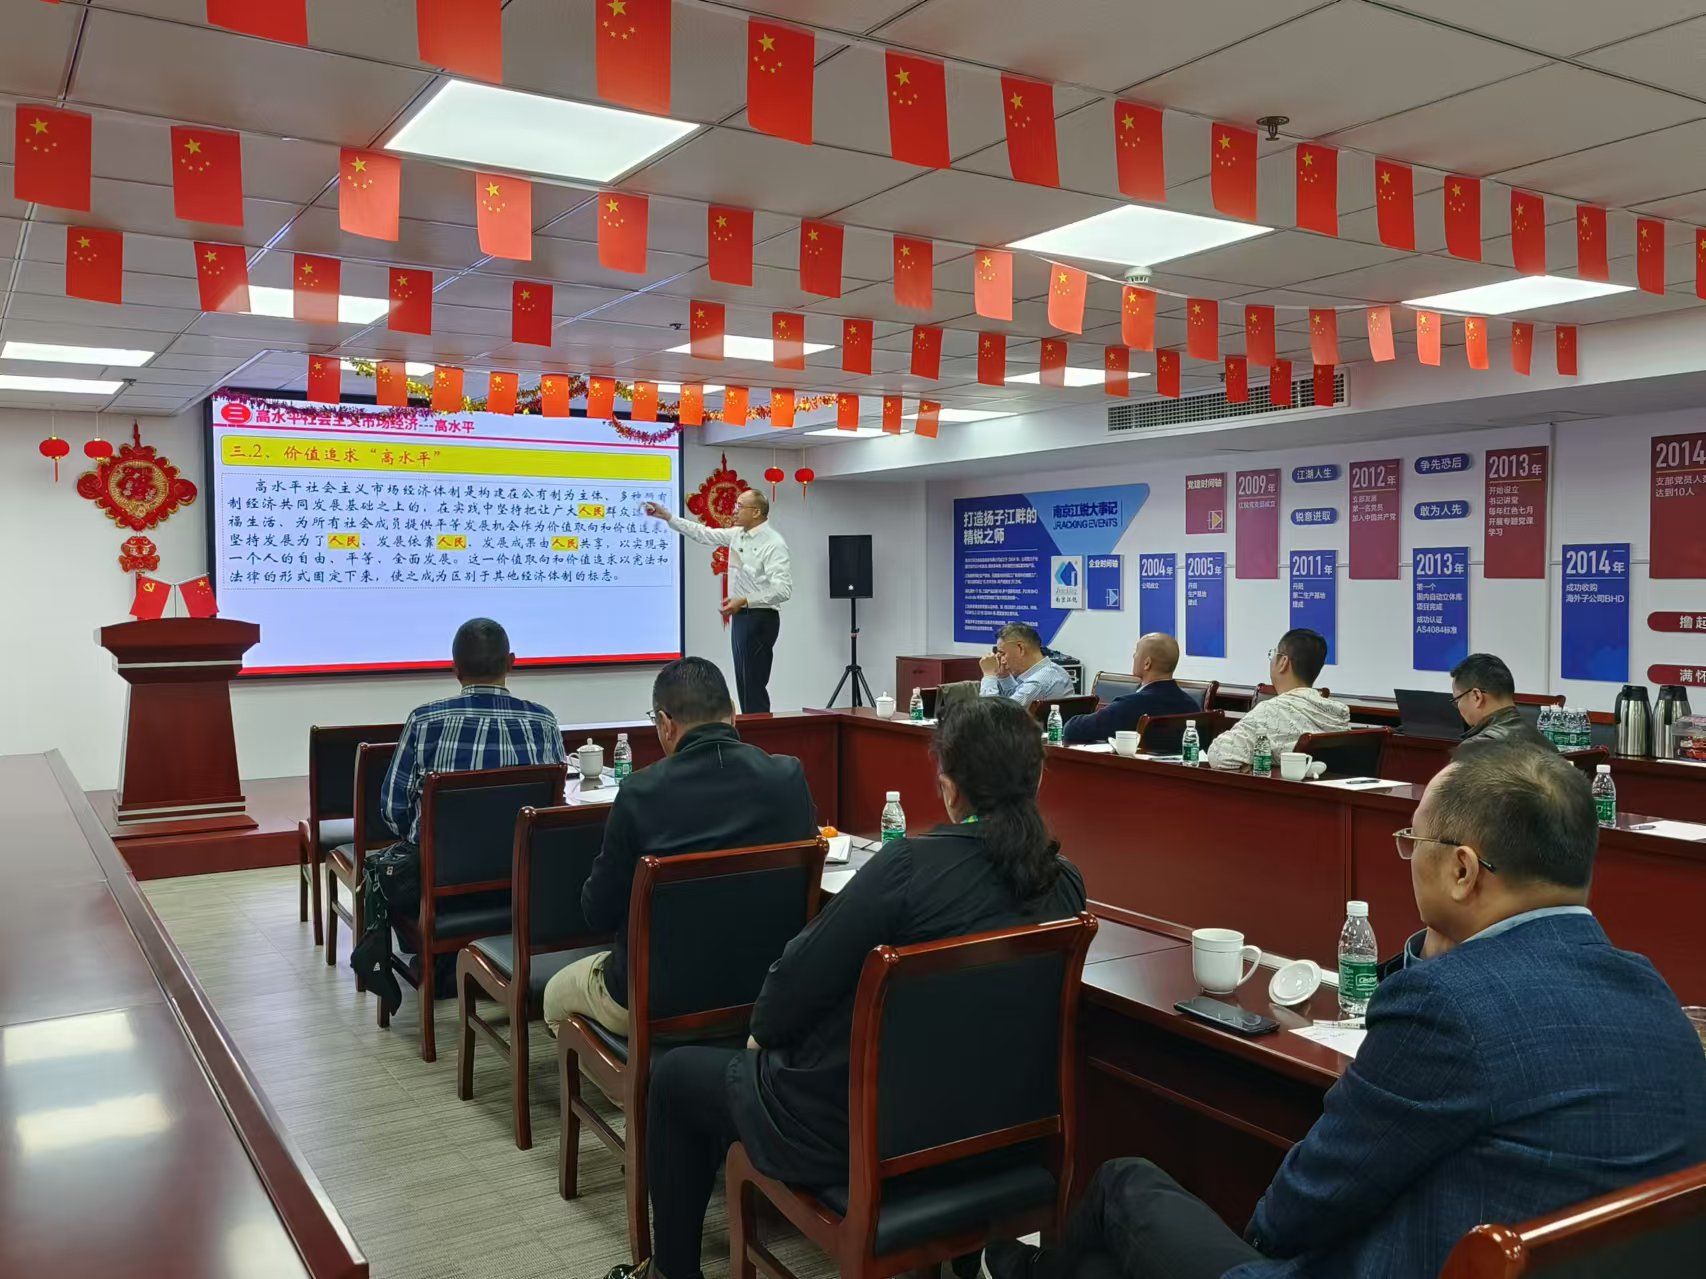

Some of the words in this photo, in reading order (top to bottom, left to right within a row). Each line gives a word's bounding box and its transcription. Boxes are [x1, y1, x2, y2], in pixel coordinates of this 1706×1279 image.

[228, 407, 245, 420] 三
[1420, 459, 1462, 471] 争先恐后
[1489, 453, 1542, 478] 2013年
[1297, 468, 1332, 480] 江湖人生
[1352, 466, 1396, 488] 2012年
[1239, 475, 1276, 494] 2009年
[1488, 486, 1519, 495] 开始设立
[1655, 487, 1695, 497] 达到10人
[1488, 496, 1519, 505] 书记讲堂
[1053, 501, 1118, 519] 南京江锐大事记
[1420, 503, 1462, 516] 敢为人先
[1488, 506, 1534, 516] 每年红色七月
[964, 507, 1038, 527] 打造扬子江畔的
[1295, 510, 1331, 522] 锐意进取
[1352, 513, 1396, 522] 加入中国共产党
[1088, 517, 1118, 528] EVENTS
[964, 528, 1005, 545] 精锐之师
[1488, 528, 1503, 537] 学习
[1141, 558, 1173, 577] 2004年
[1188, 557, 1222, 576] 2005年
[1292, 555, 1333, 576] 2011年
[1416, 553, 1464, 575] 2013年
[1566, 550, 1625, 574] 2014年
[1416, 583, 1436, 591] 第一个
[1566, 583, 1598, 592] 成功收购
[1566, 594, 1625, 603] 海外子公司BHD
[1416, 616, 1443, 624] 成功认证
